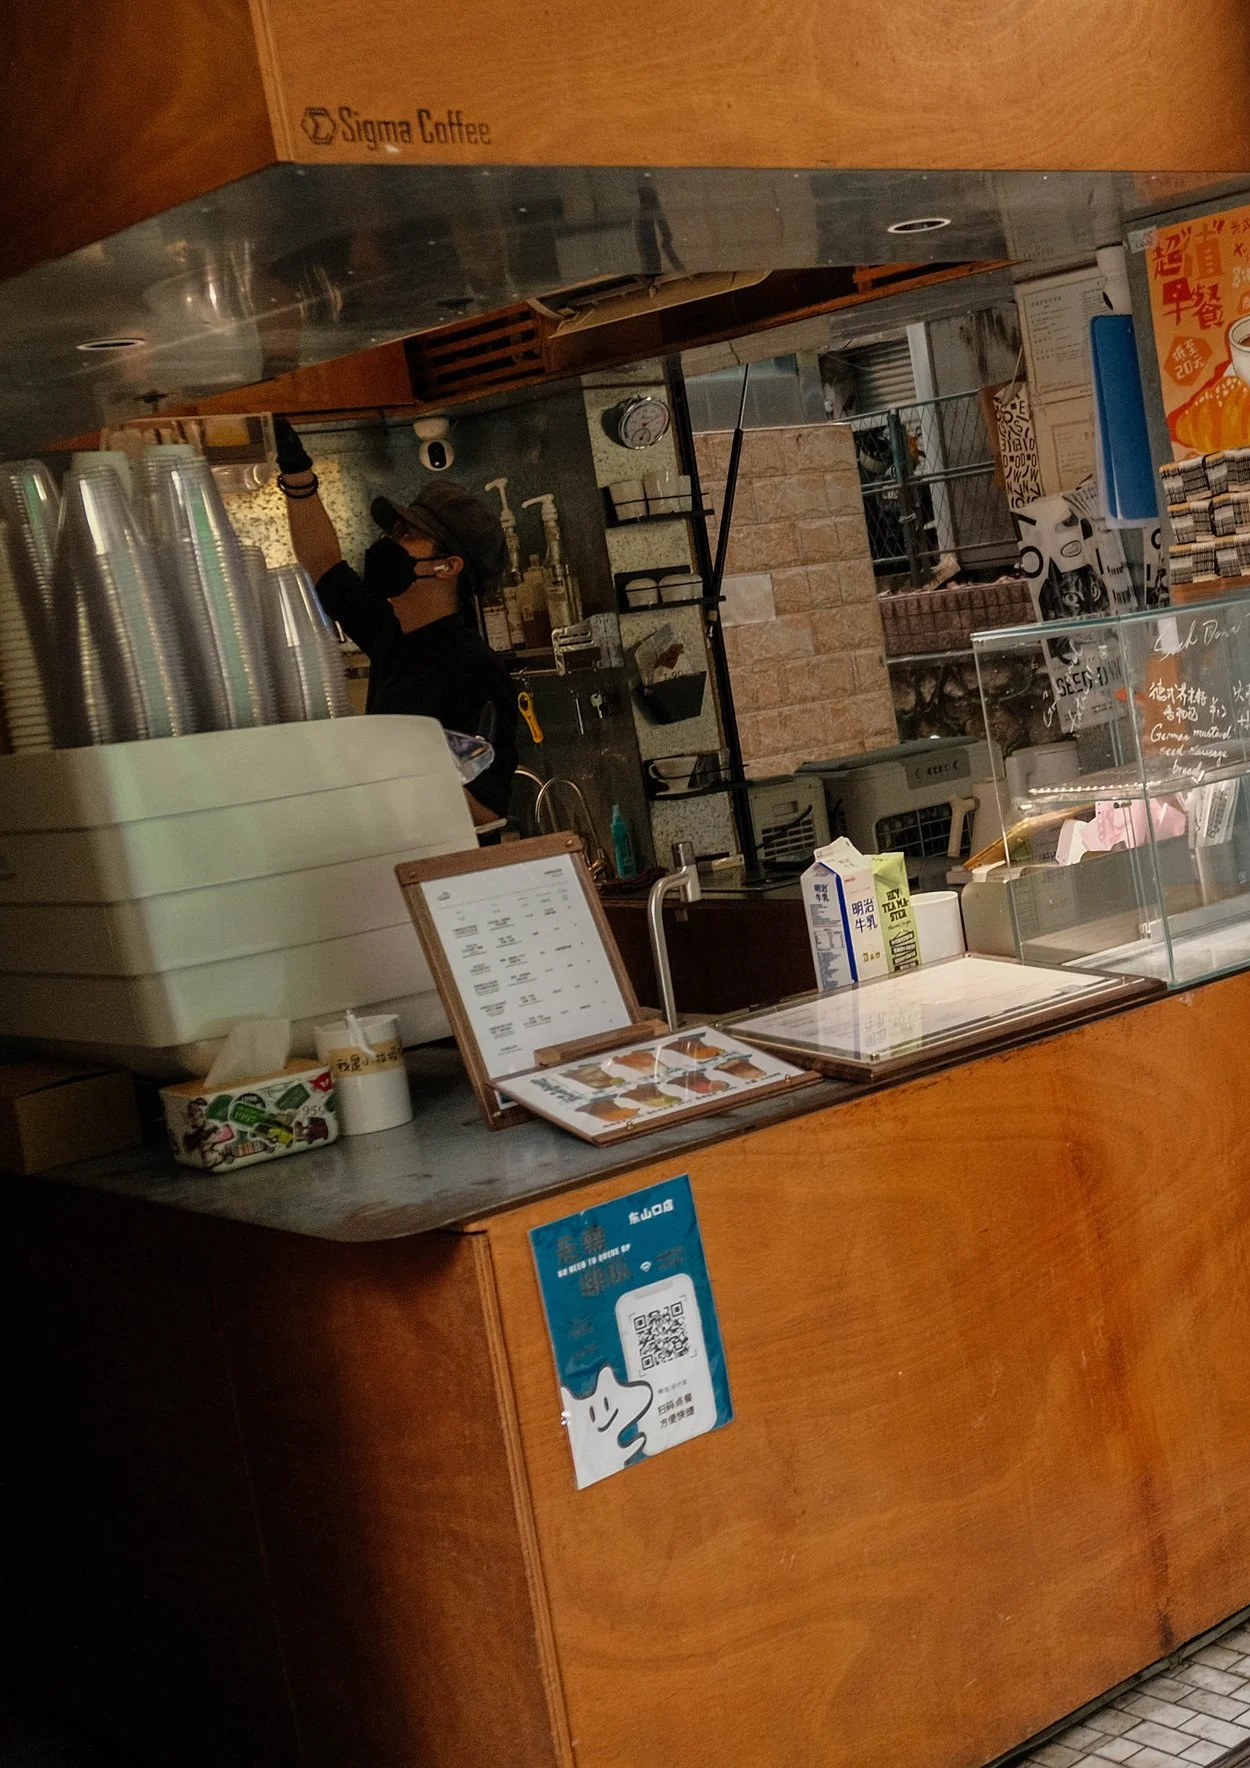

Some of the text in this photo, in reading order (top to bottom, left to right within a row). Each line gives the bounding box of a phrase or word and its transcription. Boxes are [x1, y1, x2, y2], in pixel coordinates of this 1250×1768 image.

[338, 105, 492, 150] Sigma Coffee
[1162, 276, 1225, 331] 早餐
[1056, 670, 1093, 697] SEED
[1150, 723, 1232, 743] German mustard
[1160, 744, 1185, 757] seed
[1172, 758, 1202, 776] bread
[886, 887, 900, 900] HEY
[851, 898, 875, 917] 明治
[881, 901, 897, 913] TEA
[889, 909, 908, 923] STER
[855, 914, 879, 934] 牛乳
[628, 1198, 675, 1225] 东山口店
[657, 1392, 694, 1416] 扫码点餐
[659, 1407, 696, 1430] 方便快捷
